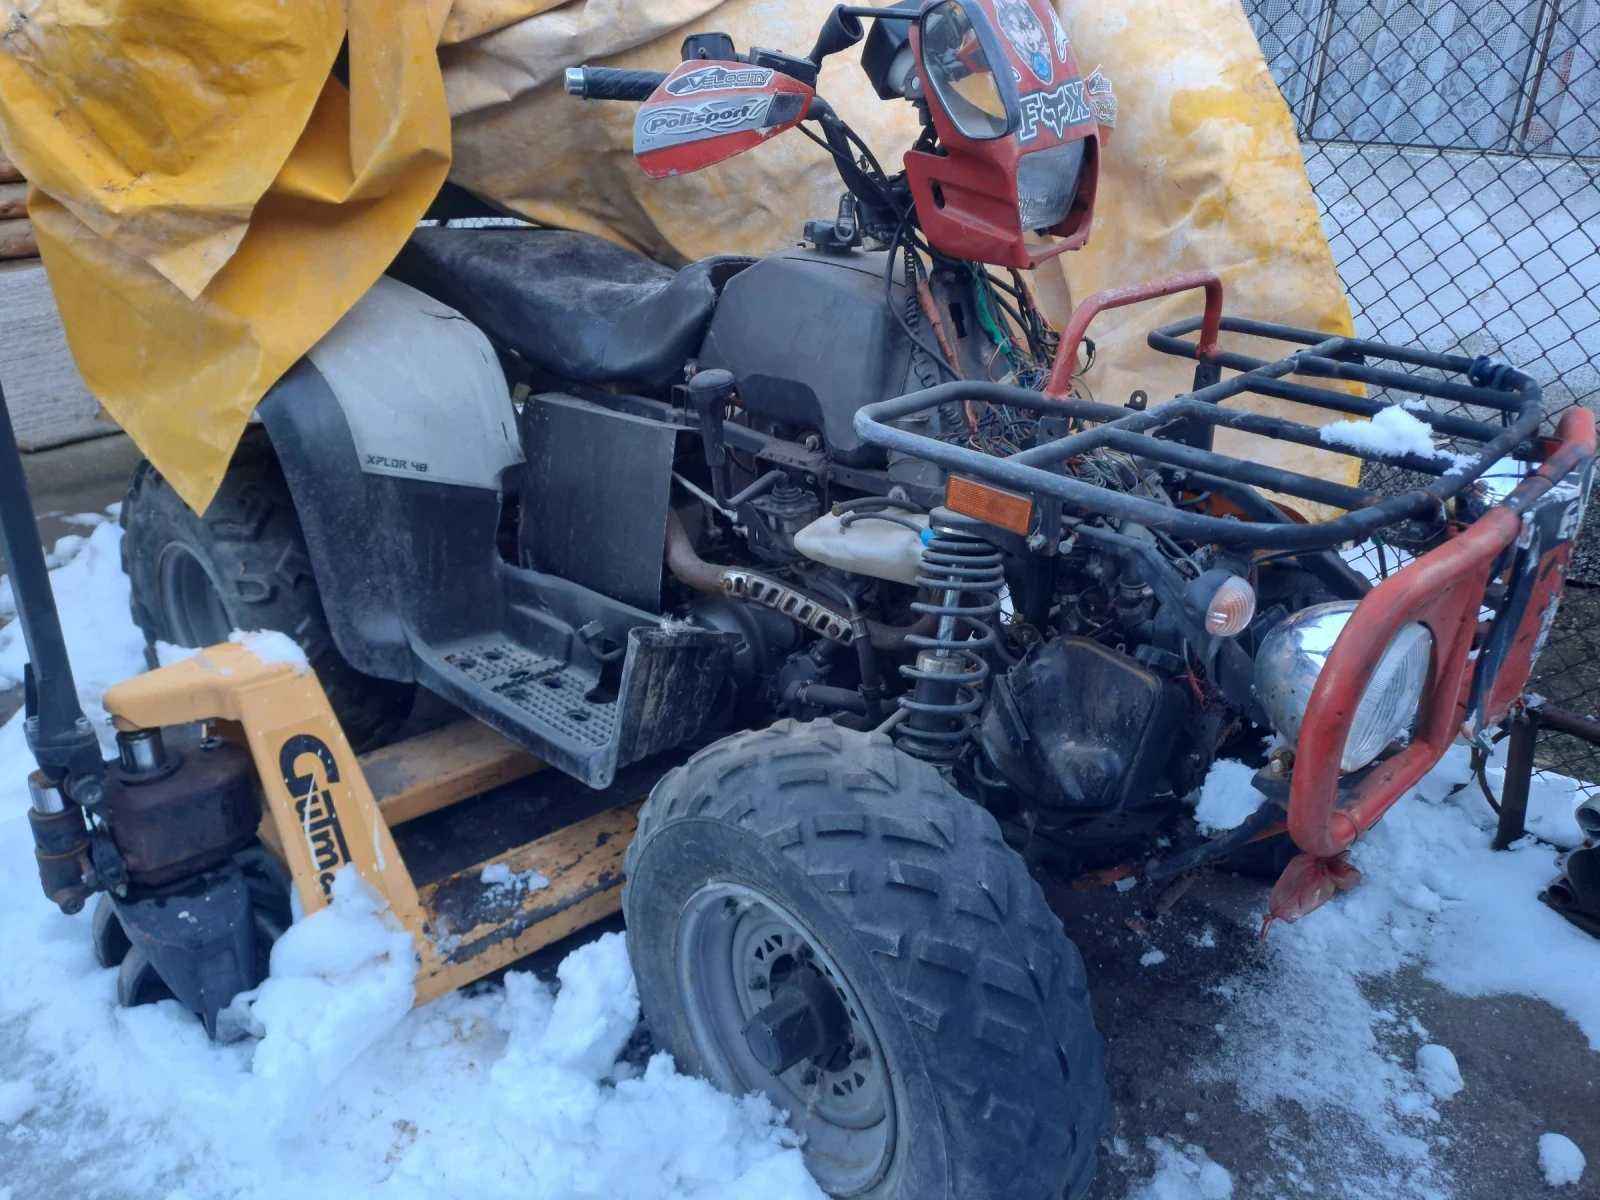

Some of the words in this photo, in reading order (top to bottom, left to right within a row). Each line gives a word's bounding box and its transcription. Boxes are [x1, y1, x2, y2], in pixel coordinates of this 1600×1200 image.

[687, 70, 772, 91] VELOCITY
[649, 105, 750, 133] Polisport
[366, 455, 407, 470] XPLOR
